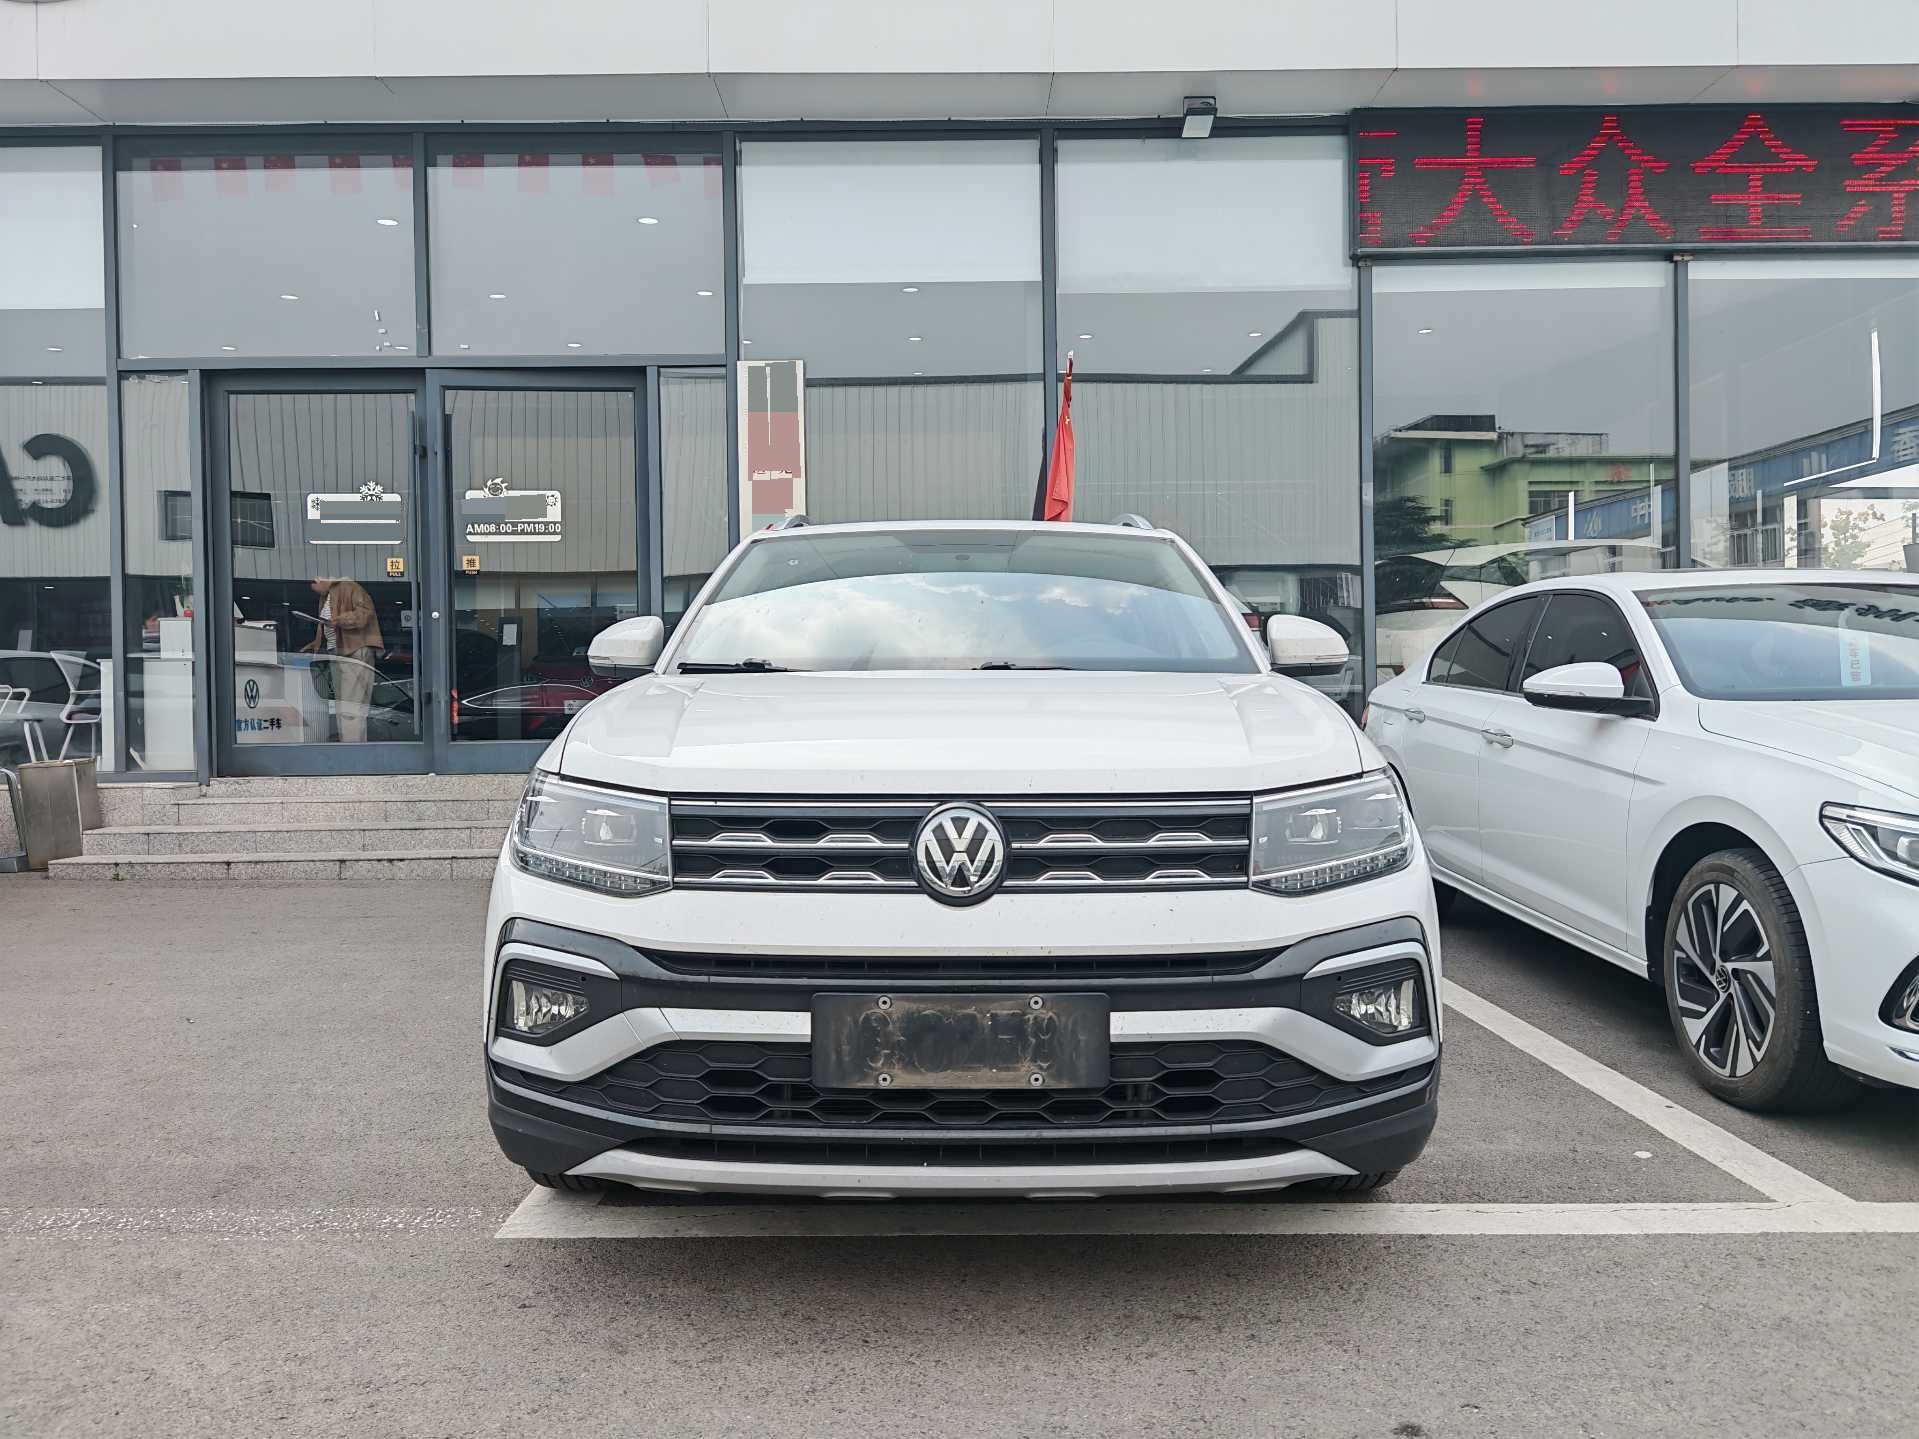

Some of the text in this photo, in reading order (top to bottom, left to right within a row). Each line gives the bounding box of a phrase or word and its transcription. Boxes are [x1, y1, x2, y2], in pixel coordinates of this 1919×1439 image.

[466, 523, 561, 533] AM08:00-PM19:00
[390, 559, 401, 570] 拉
[465, 558, 477, 568] 推
